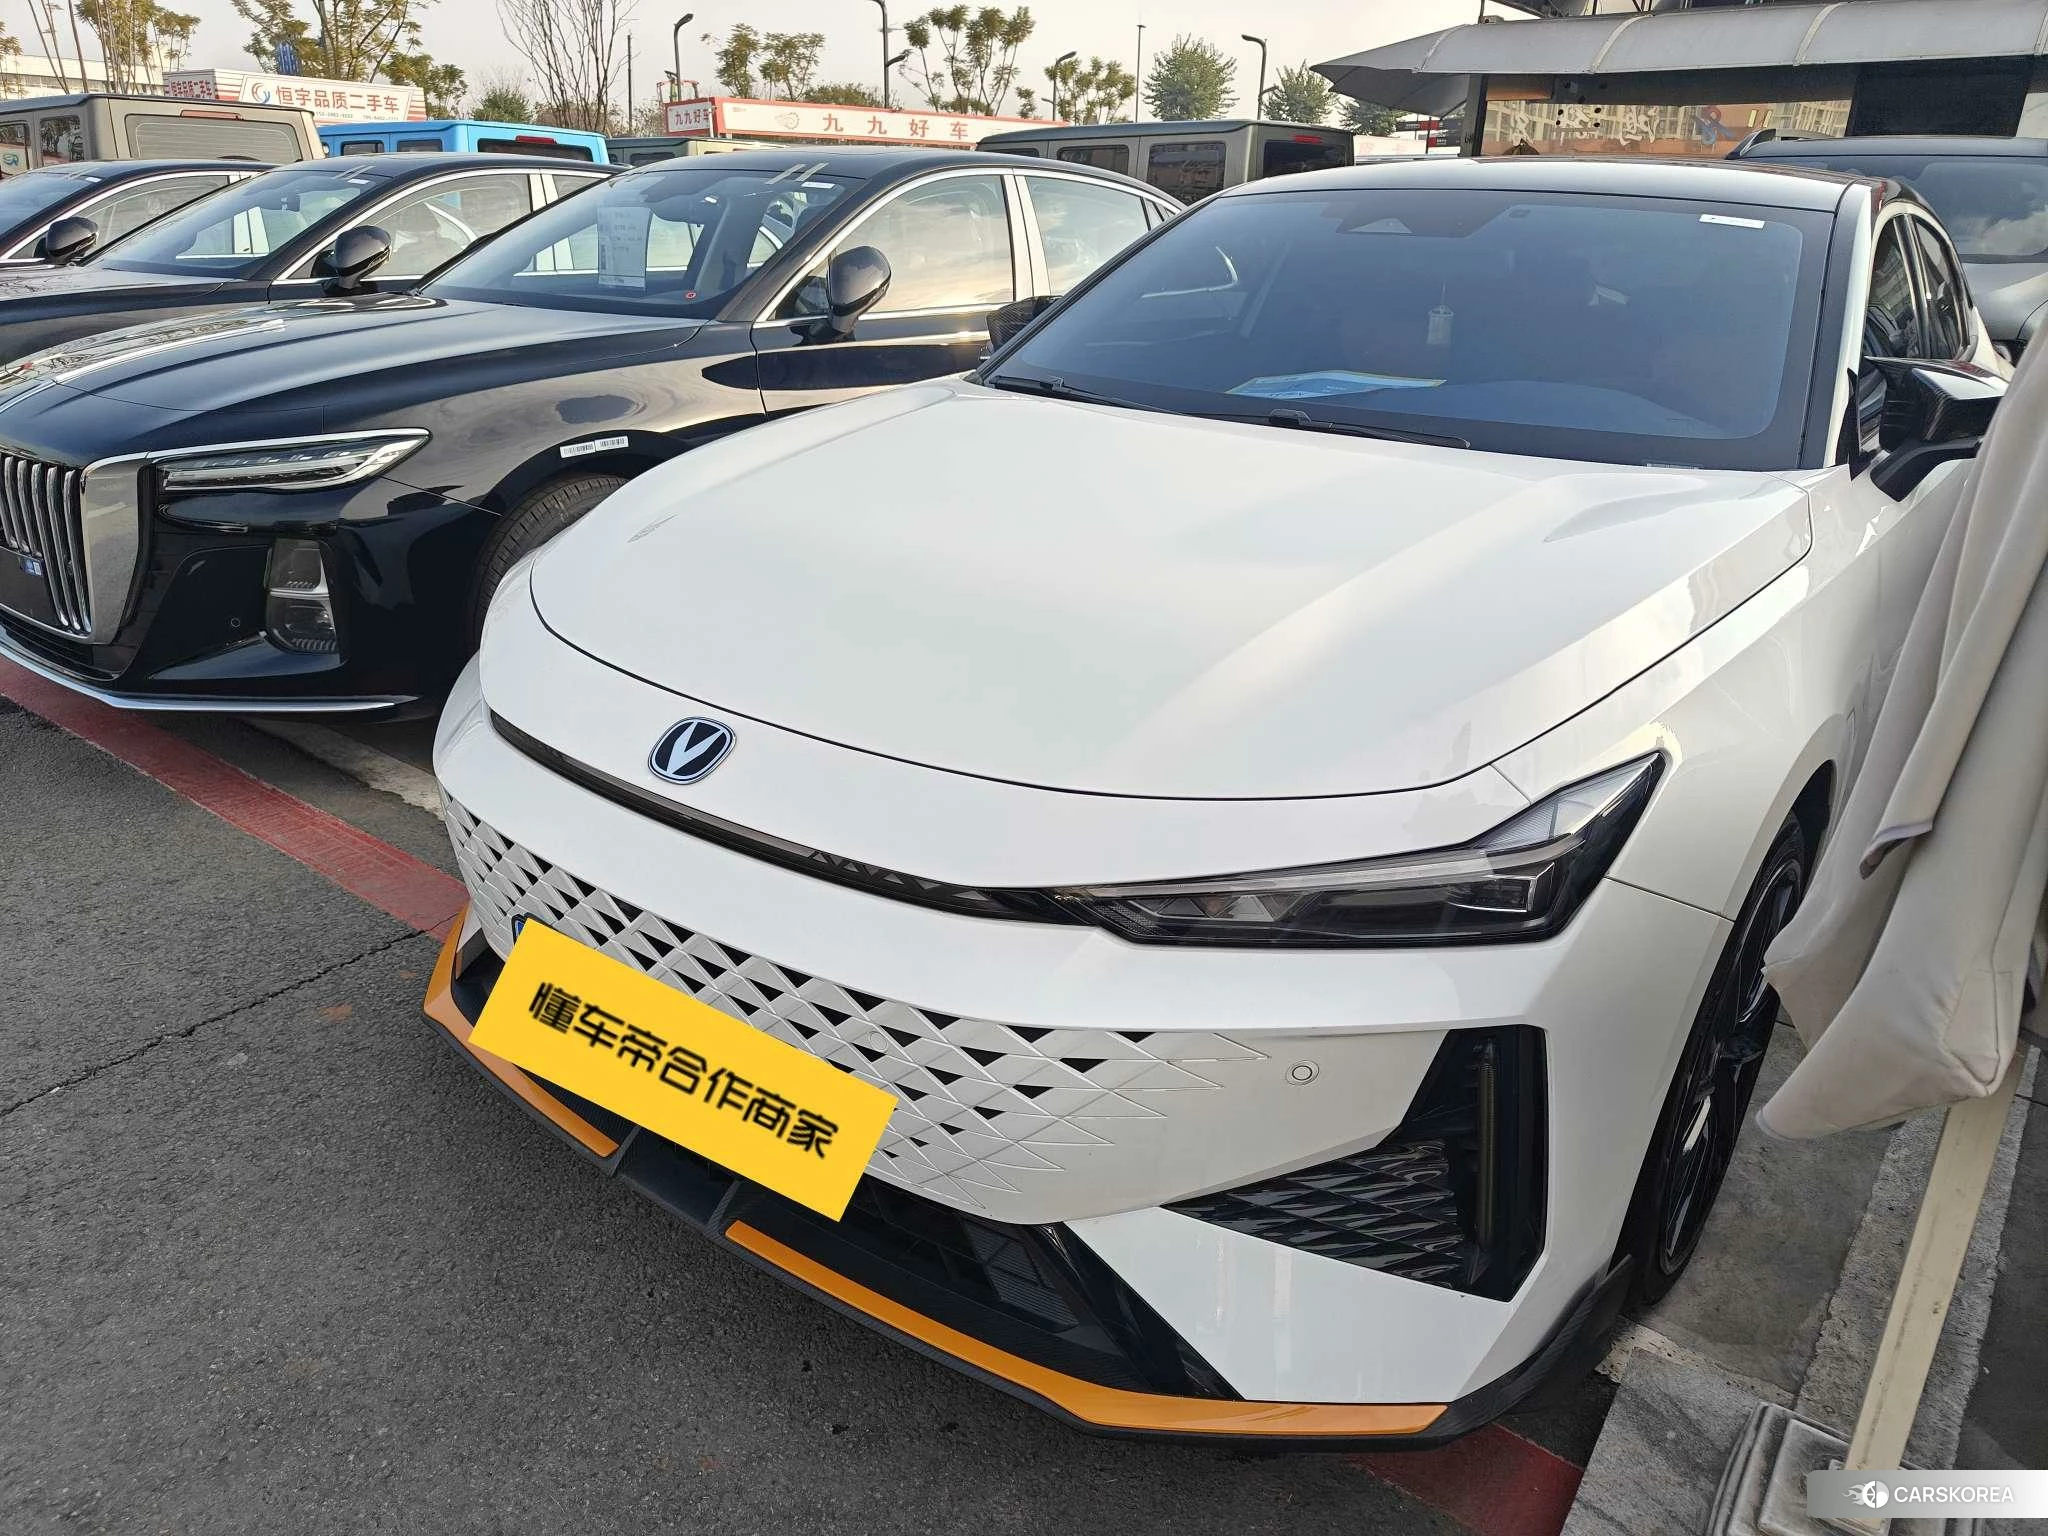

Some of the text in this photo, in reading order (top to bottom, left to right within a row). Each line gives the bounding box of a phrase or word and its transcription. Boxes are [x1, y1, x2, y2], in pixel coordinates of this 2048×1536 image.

[276, 86, 399, 113] 恒宇品质二手车
[823, 113, 968, 140] 九九好车
